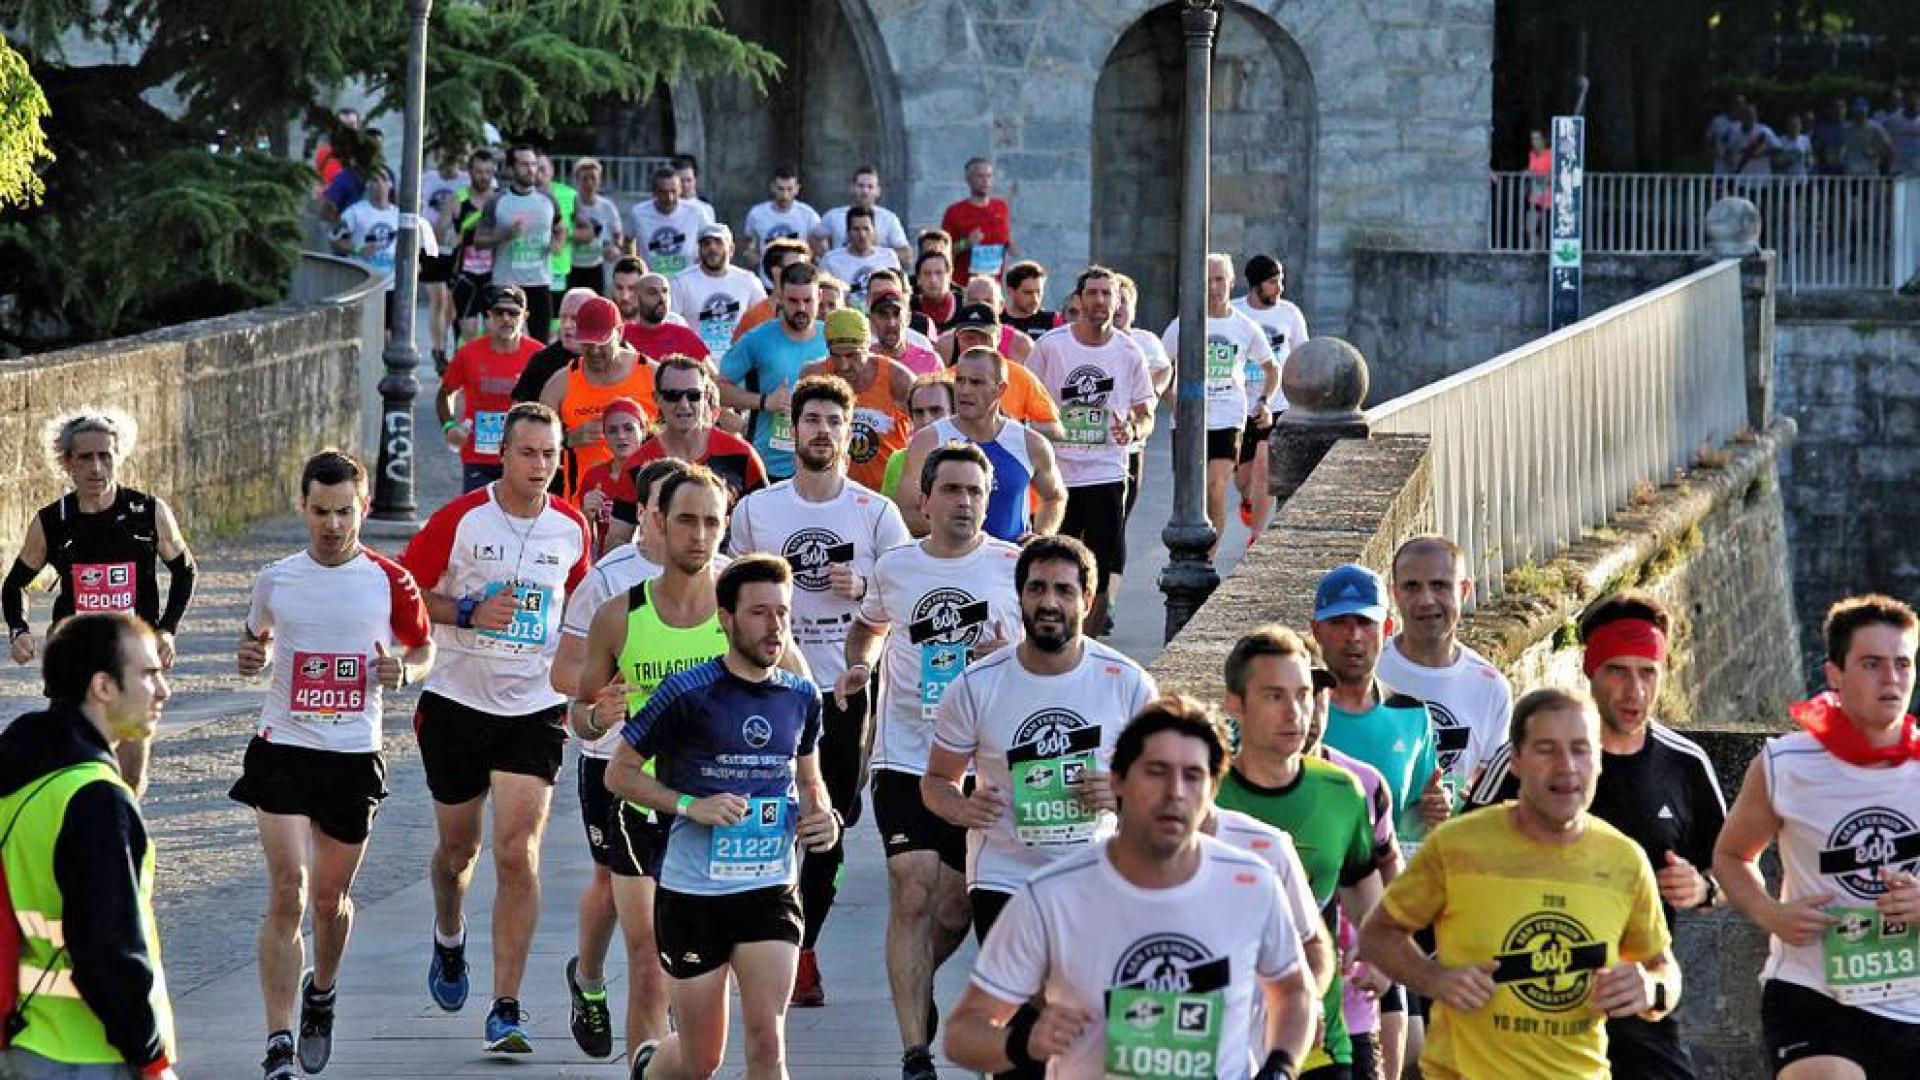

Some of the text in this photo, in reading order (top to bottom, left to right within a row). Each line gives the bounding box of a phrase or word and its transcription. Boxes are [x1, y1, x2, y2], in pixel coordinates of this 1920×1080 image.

[801, 547, 829, 567] edp
[506, 616, 544, 640] 019
[932, 606, 962, 631] edp
[296, 689, 361, 708] 42016
[1036, 732, 1071, 757] edp
[717, 837, 783, 858] 21227
[1855, 836, 1896, 867] edp
[1531, 944, 1573, 975] edp
[1832, 948, 1915, 979] 10513
[1113, 1045, 1212, 1077] 10902
